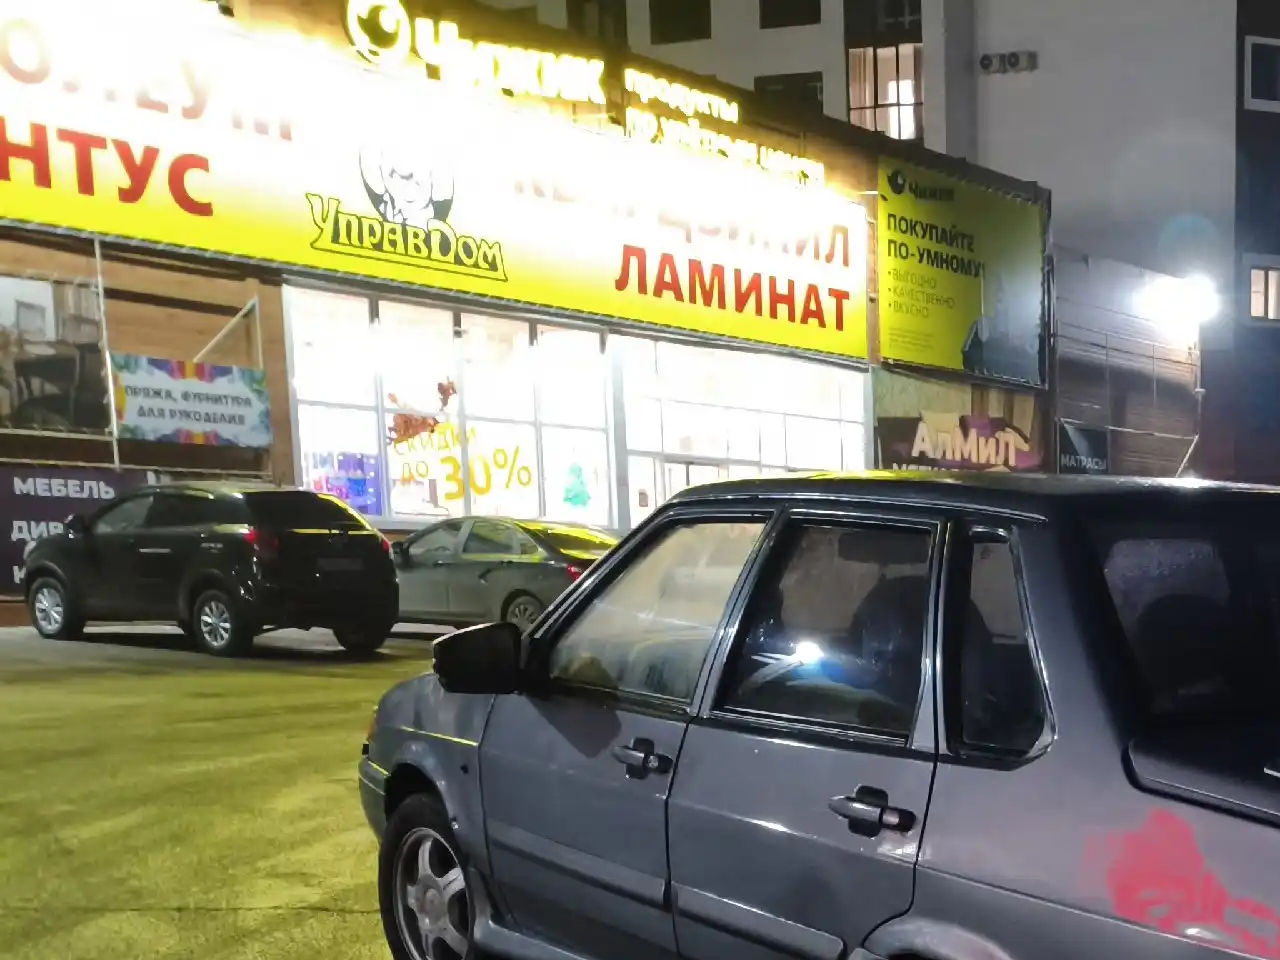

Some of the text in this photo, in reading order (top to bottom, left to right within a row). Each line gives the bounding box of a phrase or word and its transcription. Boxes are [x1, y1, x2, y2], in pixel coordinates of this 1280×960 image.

[0, 116, 214, 217] НТУС
[888, 213, 974, 253] ПОКУПАЙТЕ
[615, 243, 850, 332] ЛАМИНАТ
[137, 405, 246, 426] ДЛЯ РУКОДЕЛИЯ
[1061, 453, 1107, 470] МАТРАСЫ
[13, 476, 116, 500] МЕБЕЛЬ
